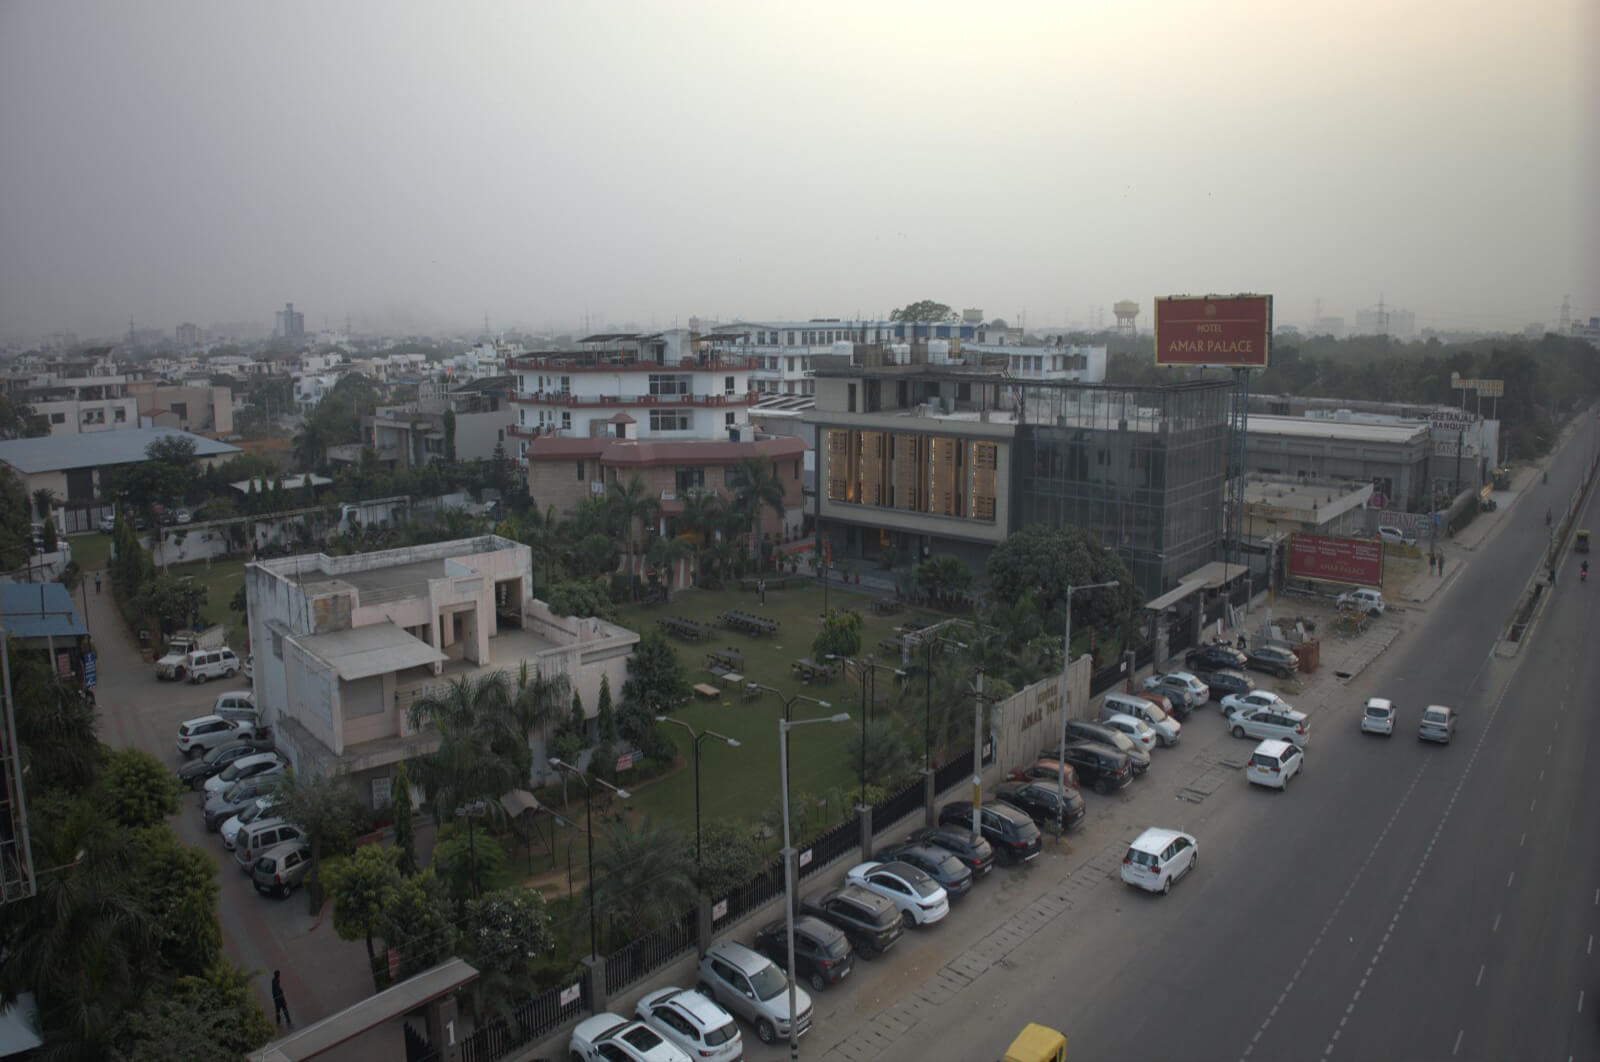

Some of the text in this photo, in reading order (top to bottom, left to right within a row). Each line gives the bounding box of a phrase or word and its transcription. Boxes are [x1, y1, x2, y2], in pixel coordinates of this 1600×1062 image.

[1197, 324, 1222, 333] HOTEL
[1169, 340, 1253, 353] AMAR PALACE
